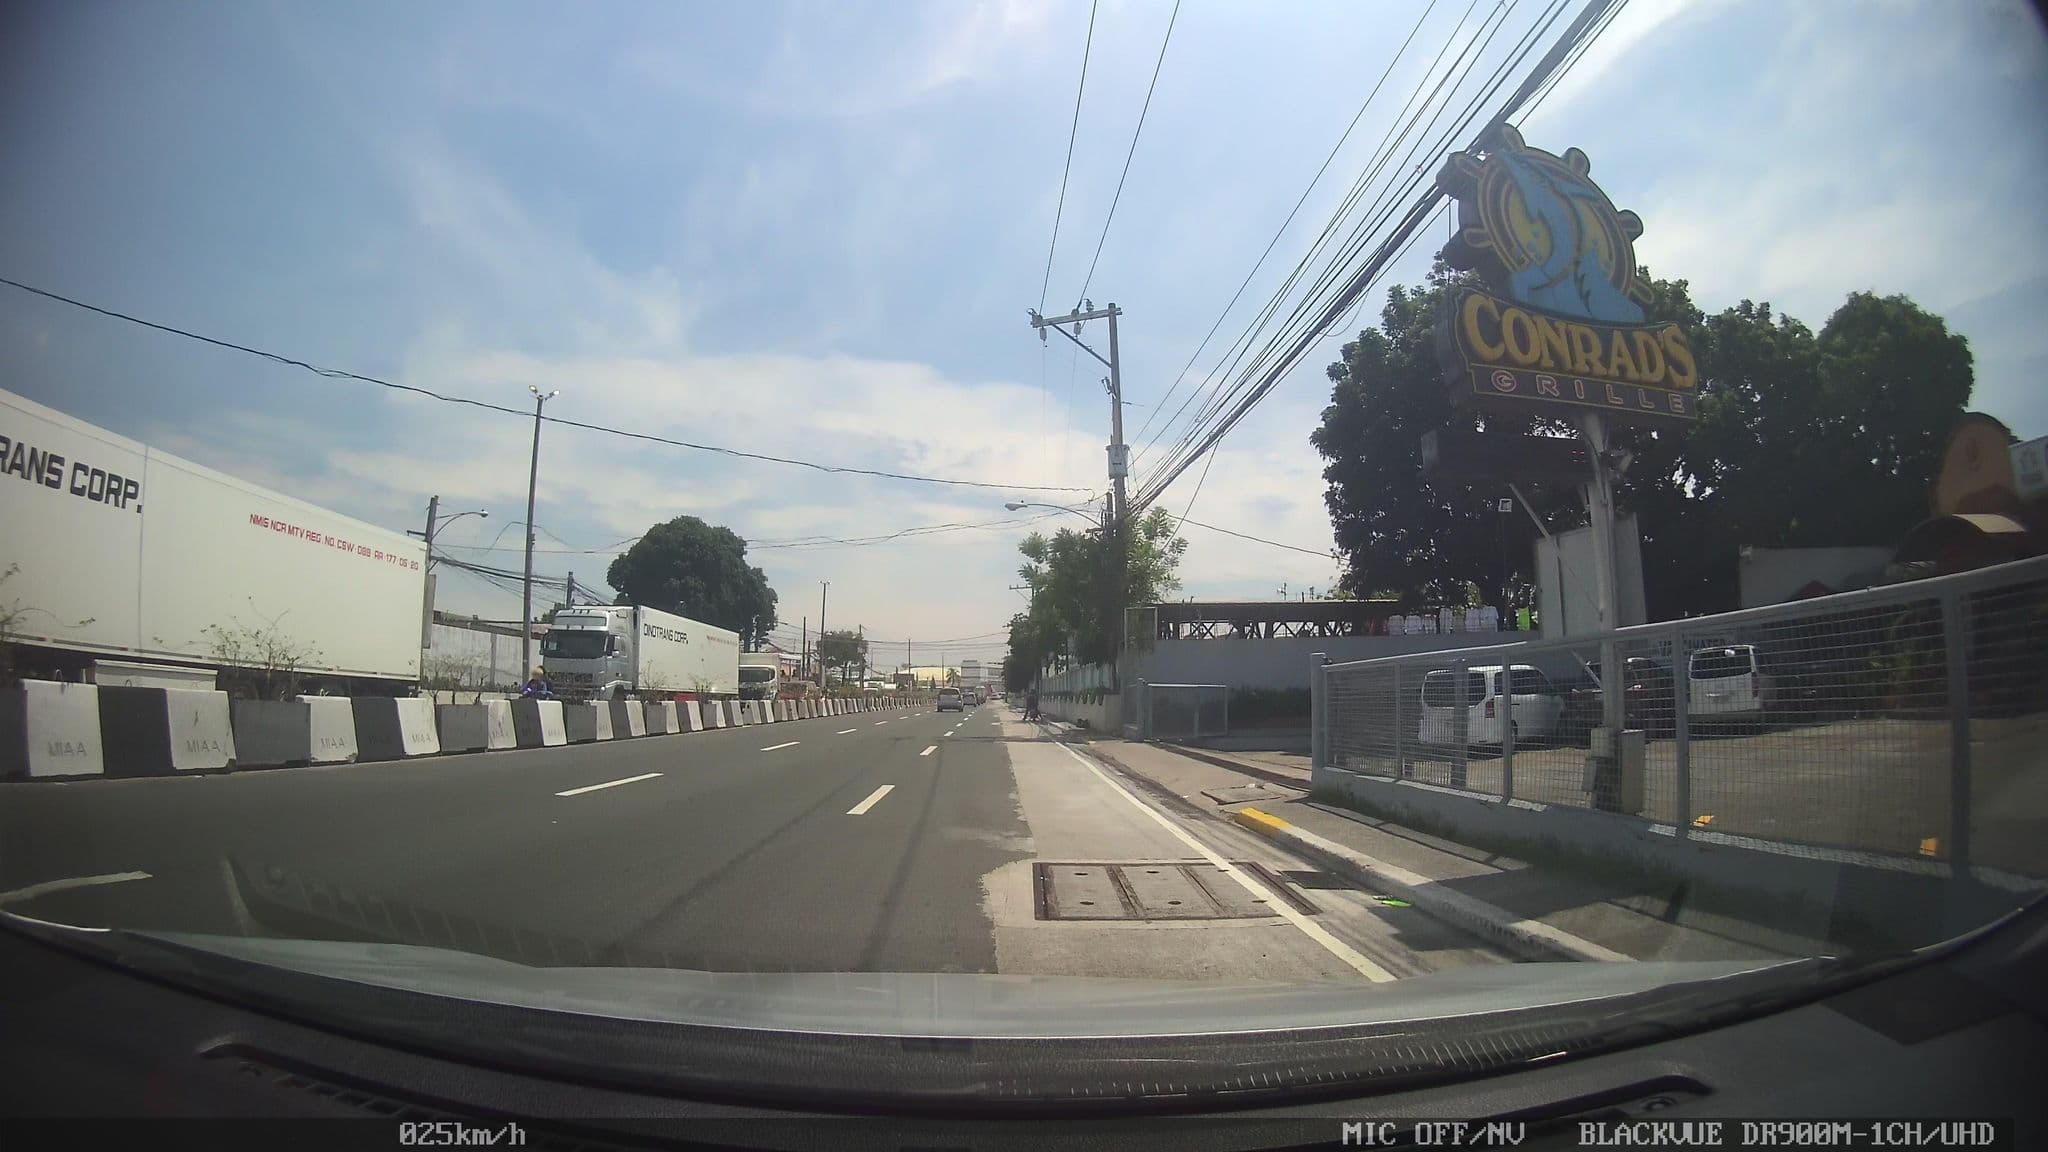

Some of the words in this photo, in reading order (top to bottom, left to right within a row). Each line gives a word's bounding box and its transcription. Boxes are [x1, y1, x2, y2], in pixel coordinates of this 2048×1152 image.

[1464, 293, 1698, 389] CONRAD'S
[1490, 369, 1686, 413] GRILLE
[70, 461, 143, 514] CORP.
[270, 519, 287, 533] NCR
